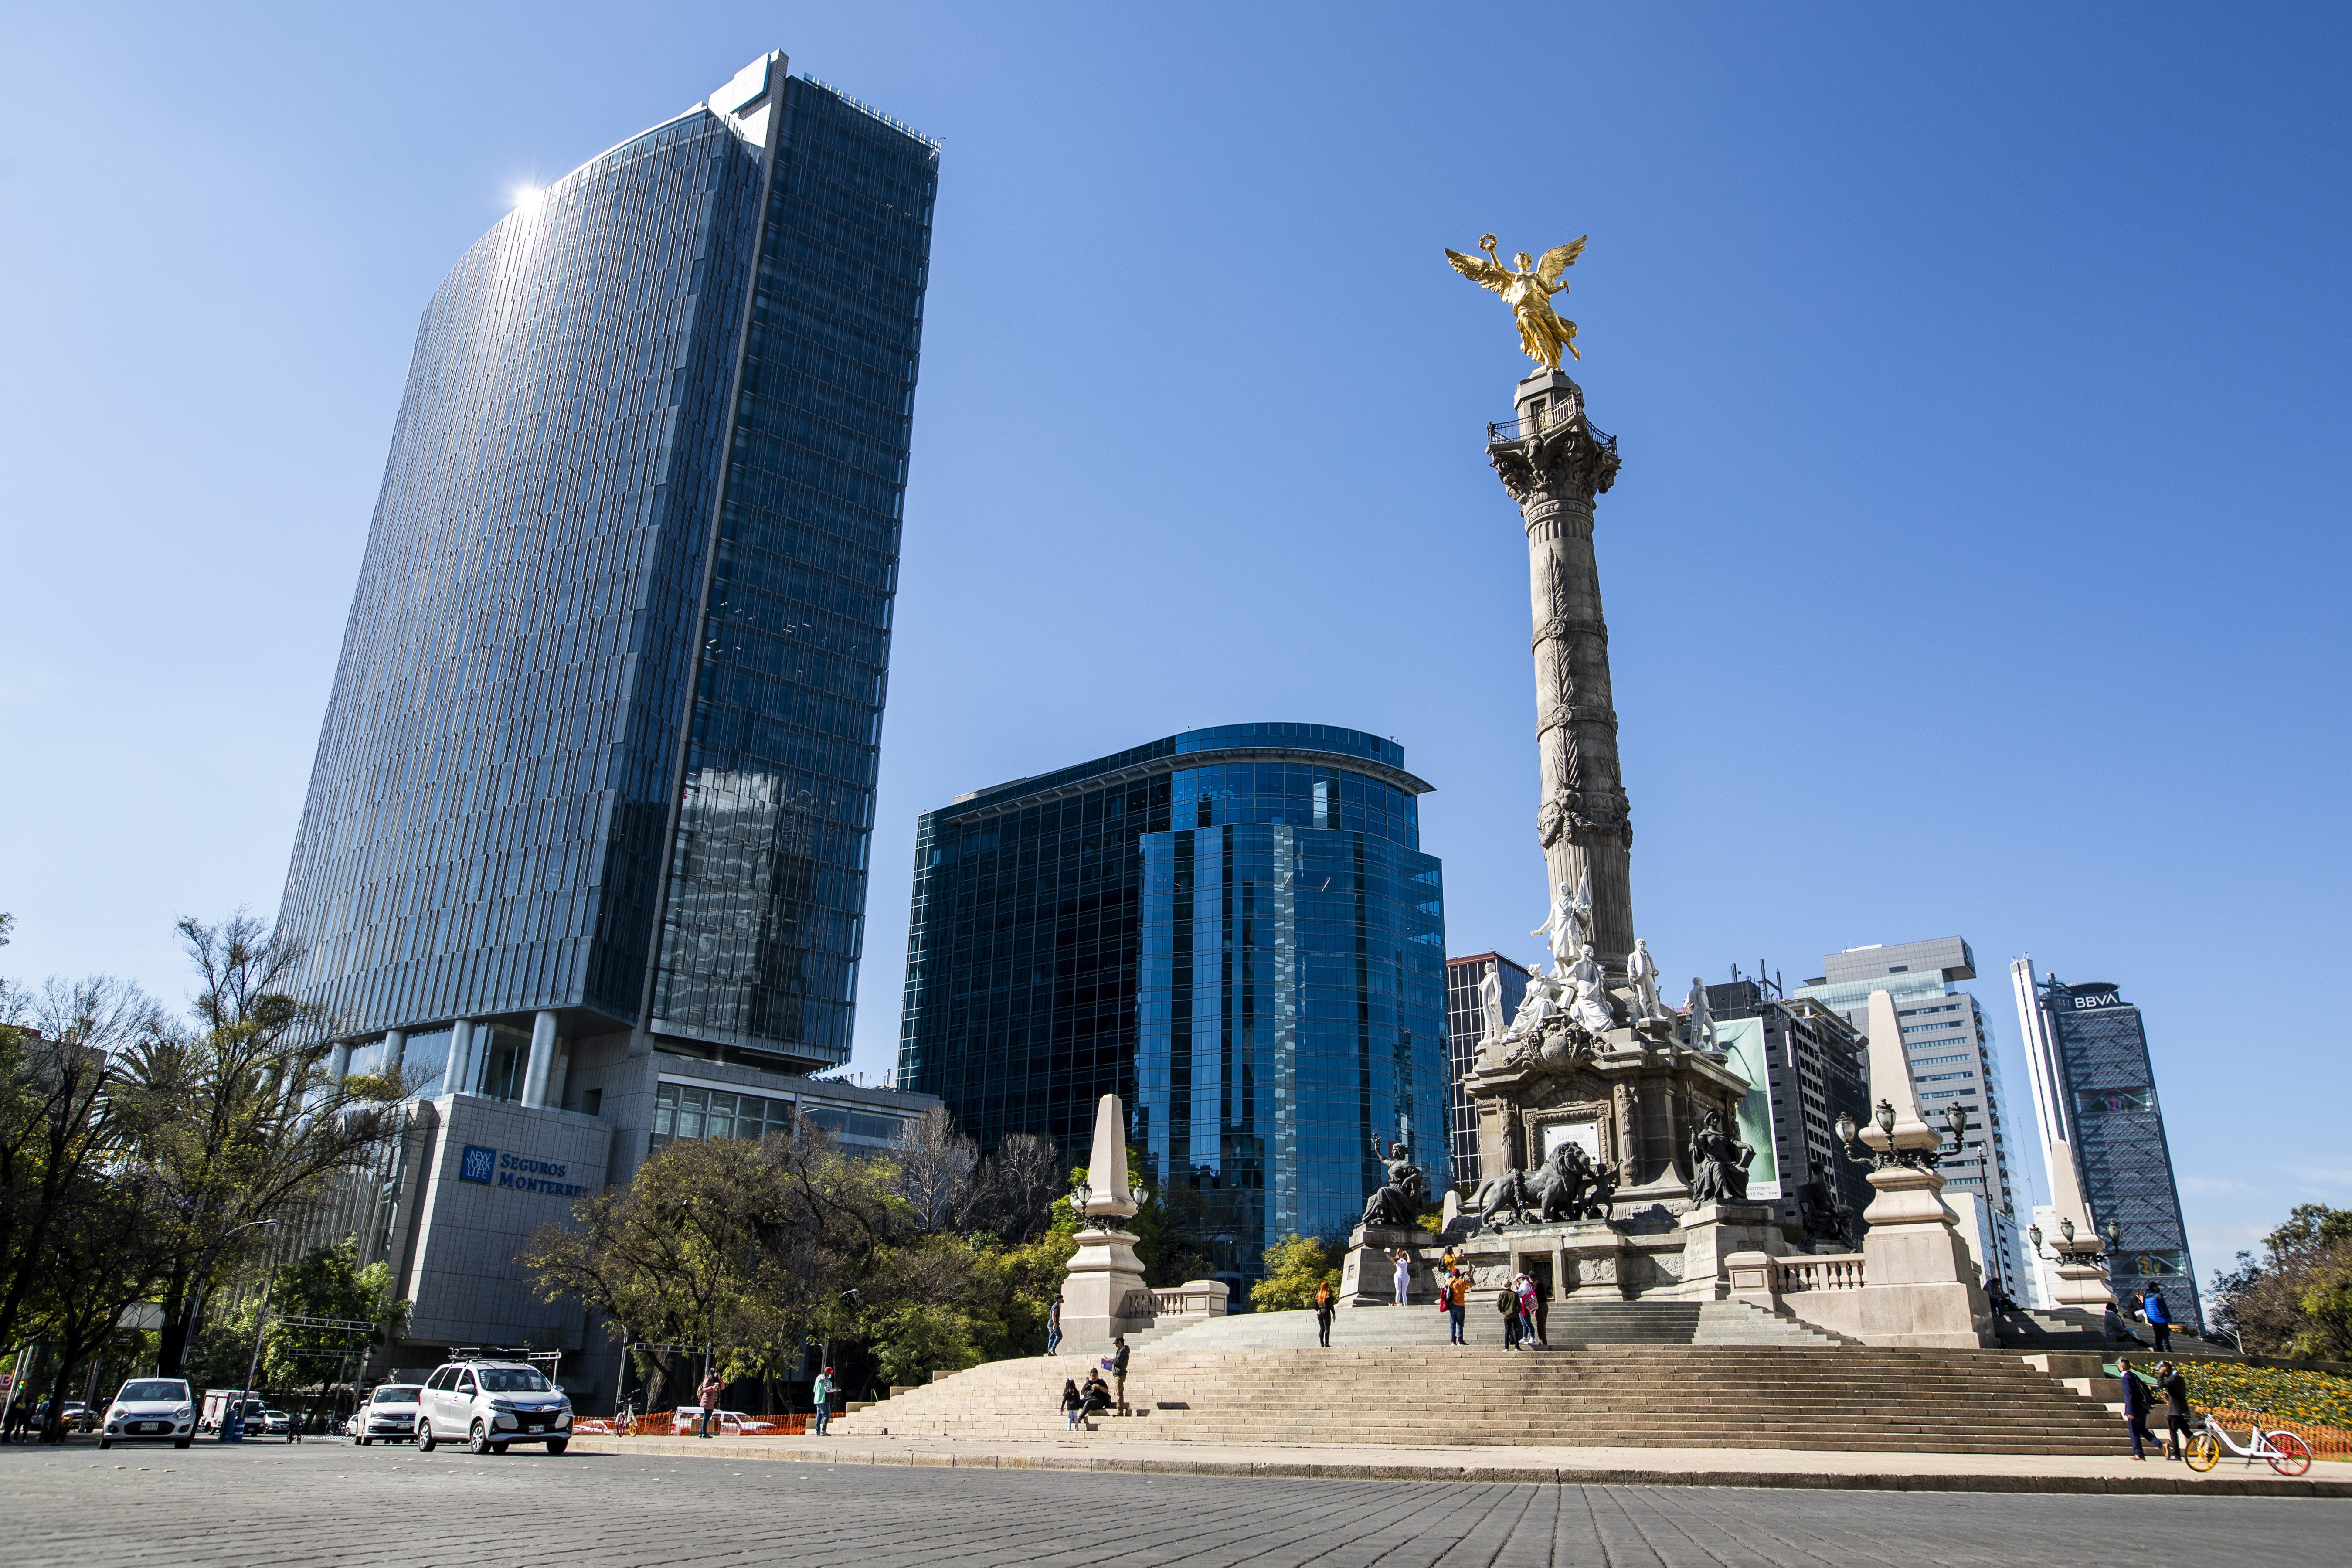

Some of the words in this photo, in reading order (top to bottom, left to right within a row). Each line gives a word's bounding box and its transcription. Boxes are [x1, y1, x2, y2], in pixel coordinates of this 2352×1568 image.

[2075, 993, 2118, 1008] BBVA
[470, 1150, 491, 1161] NEW
[466, 1158, 492, 1171] YORK
[501, 1153, 566, 1177] SEGUROS
[467, 1167, 487, 1178] LIFE
